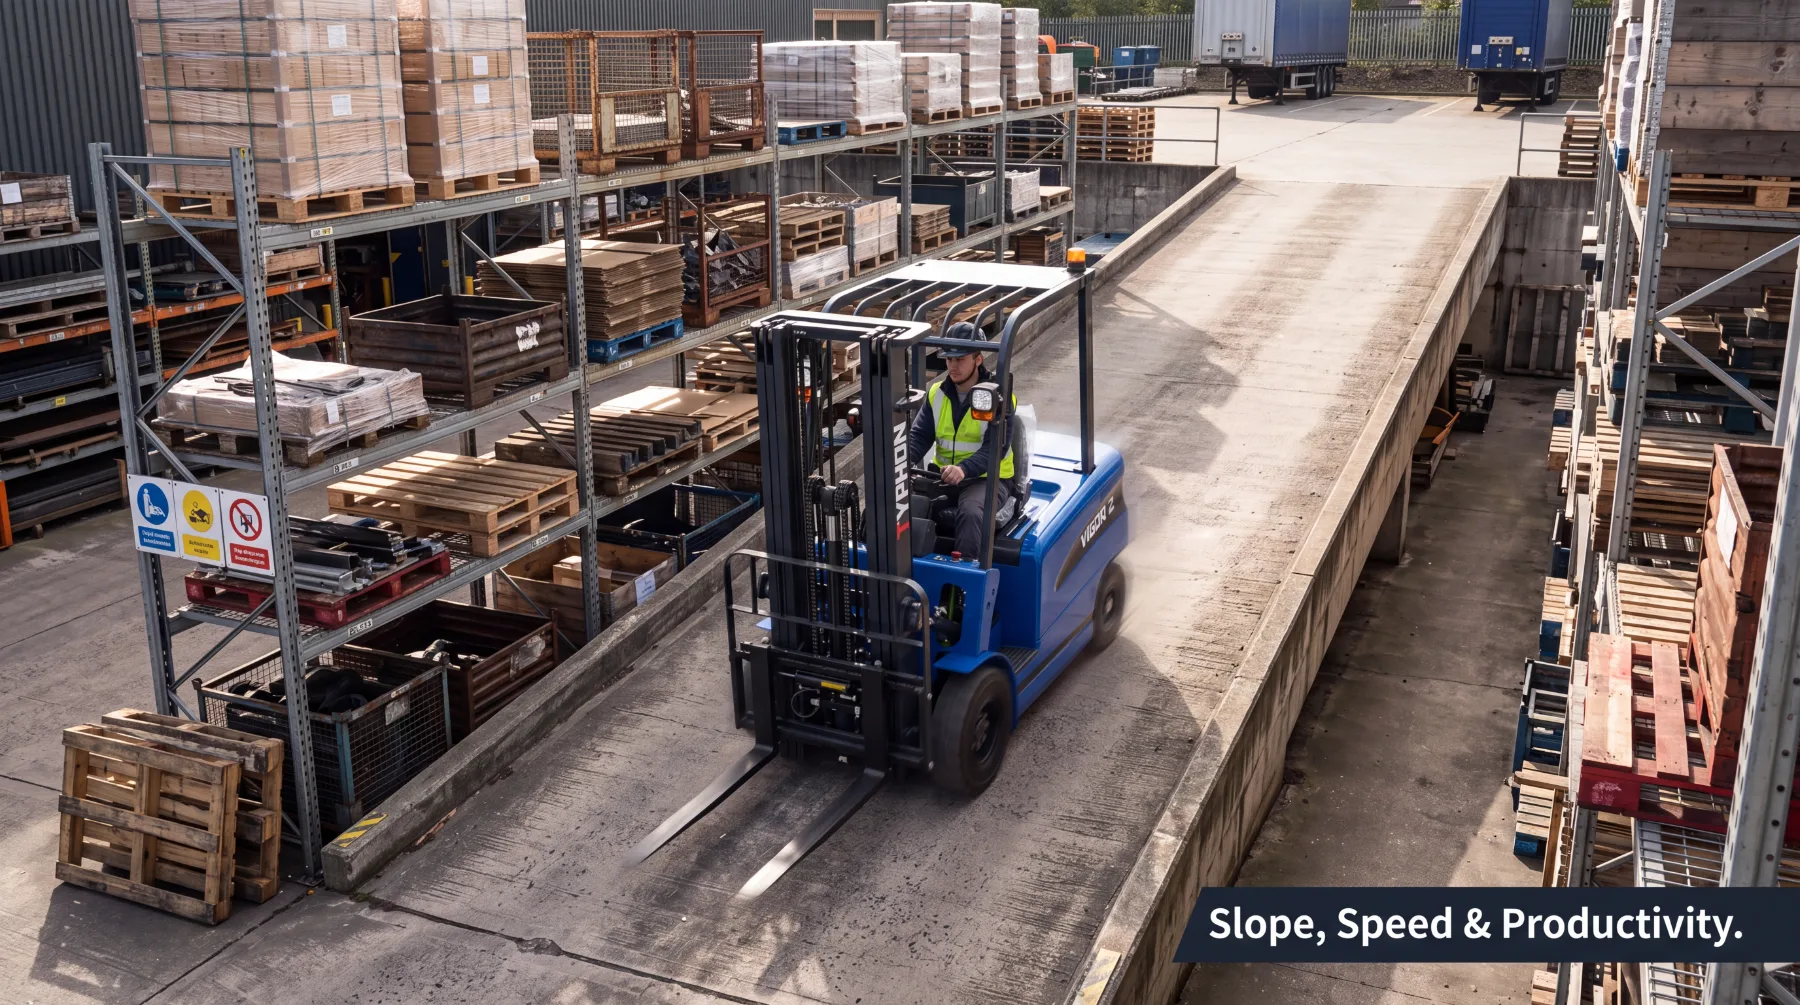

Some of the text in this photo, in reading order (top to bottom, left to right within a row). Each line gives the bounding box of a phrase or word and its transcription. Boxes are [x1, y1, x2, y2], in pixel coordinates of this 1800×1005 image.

[893, 421, 911, 541] TYPHON
[1080, 495, 1115, 549] VIGOR 2
